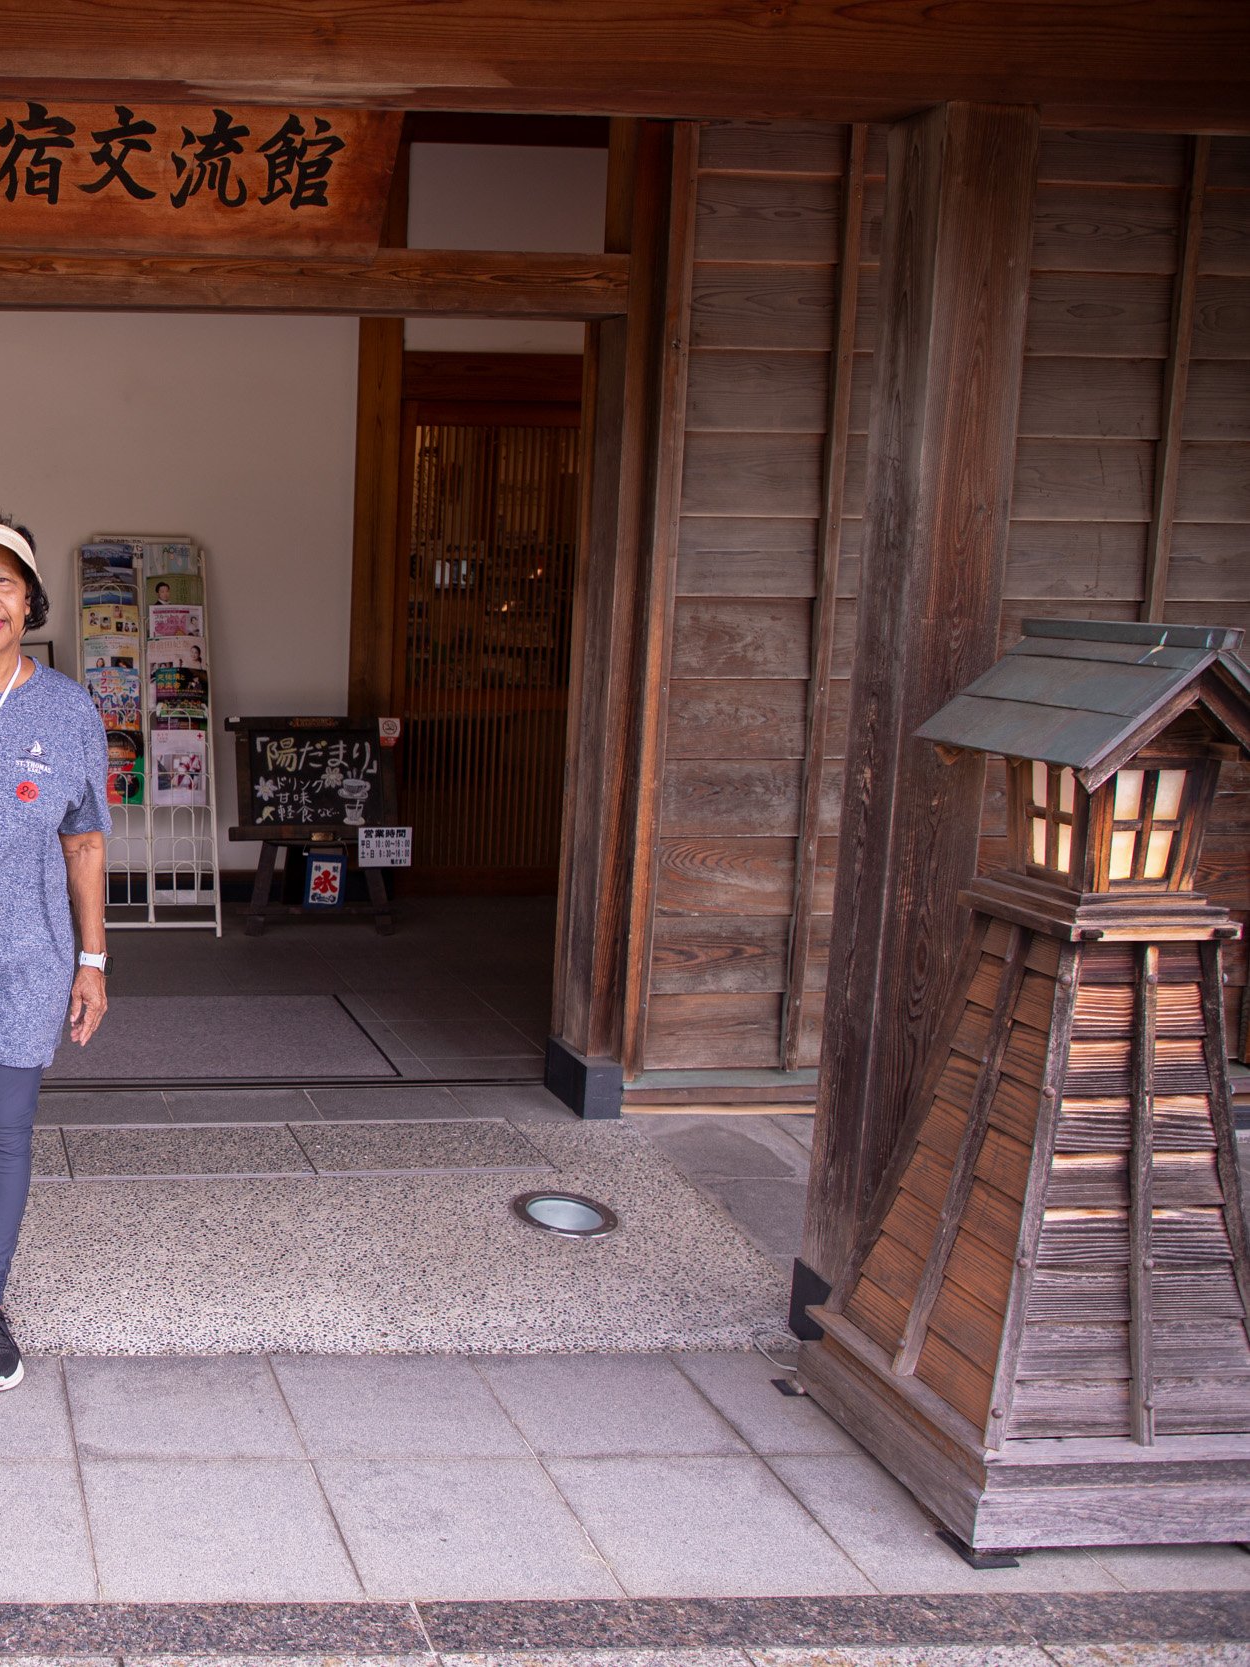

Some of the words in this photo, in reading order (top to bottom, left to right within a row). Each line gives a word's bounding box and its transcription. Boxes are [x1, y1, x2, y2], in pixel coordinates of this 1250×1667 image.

[276, 776, 324, 793] ドリンク
[20, 785, 36, 799] 20
[276, 792, 312, 804] 甘味
[277, 806, 314, 823] 軽食
[364, 829, 407, 839] 営業時間
[361, 840, 371, 849] 平日
[311, 869, 338, 894] 氷
